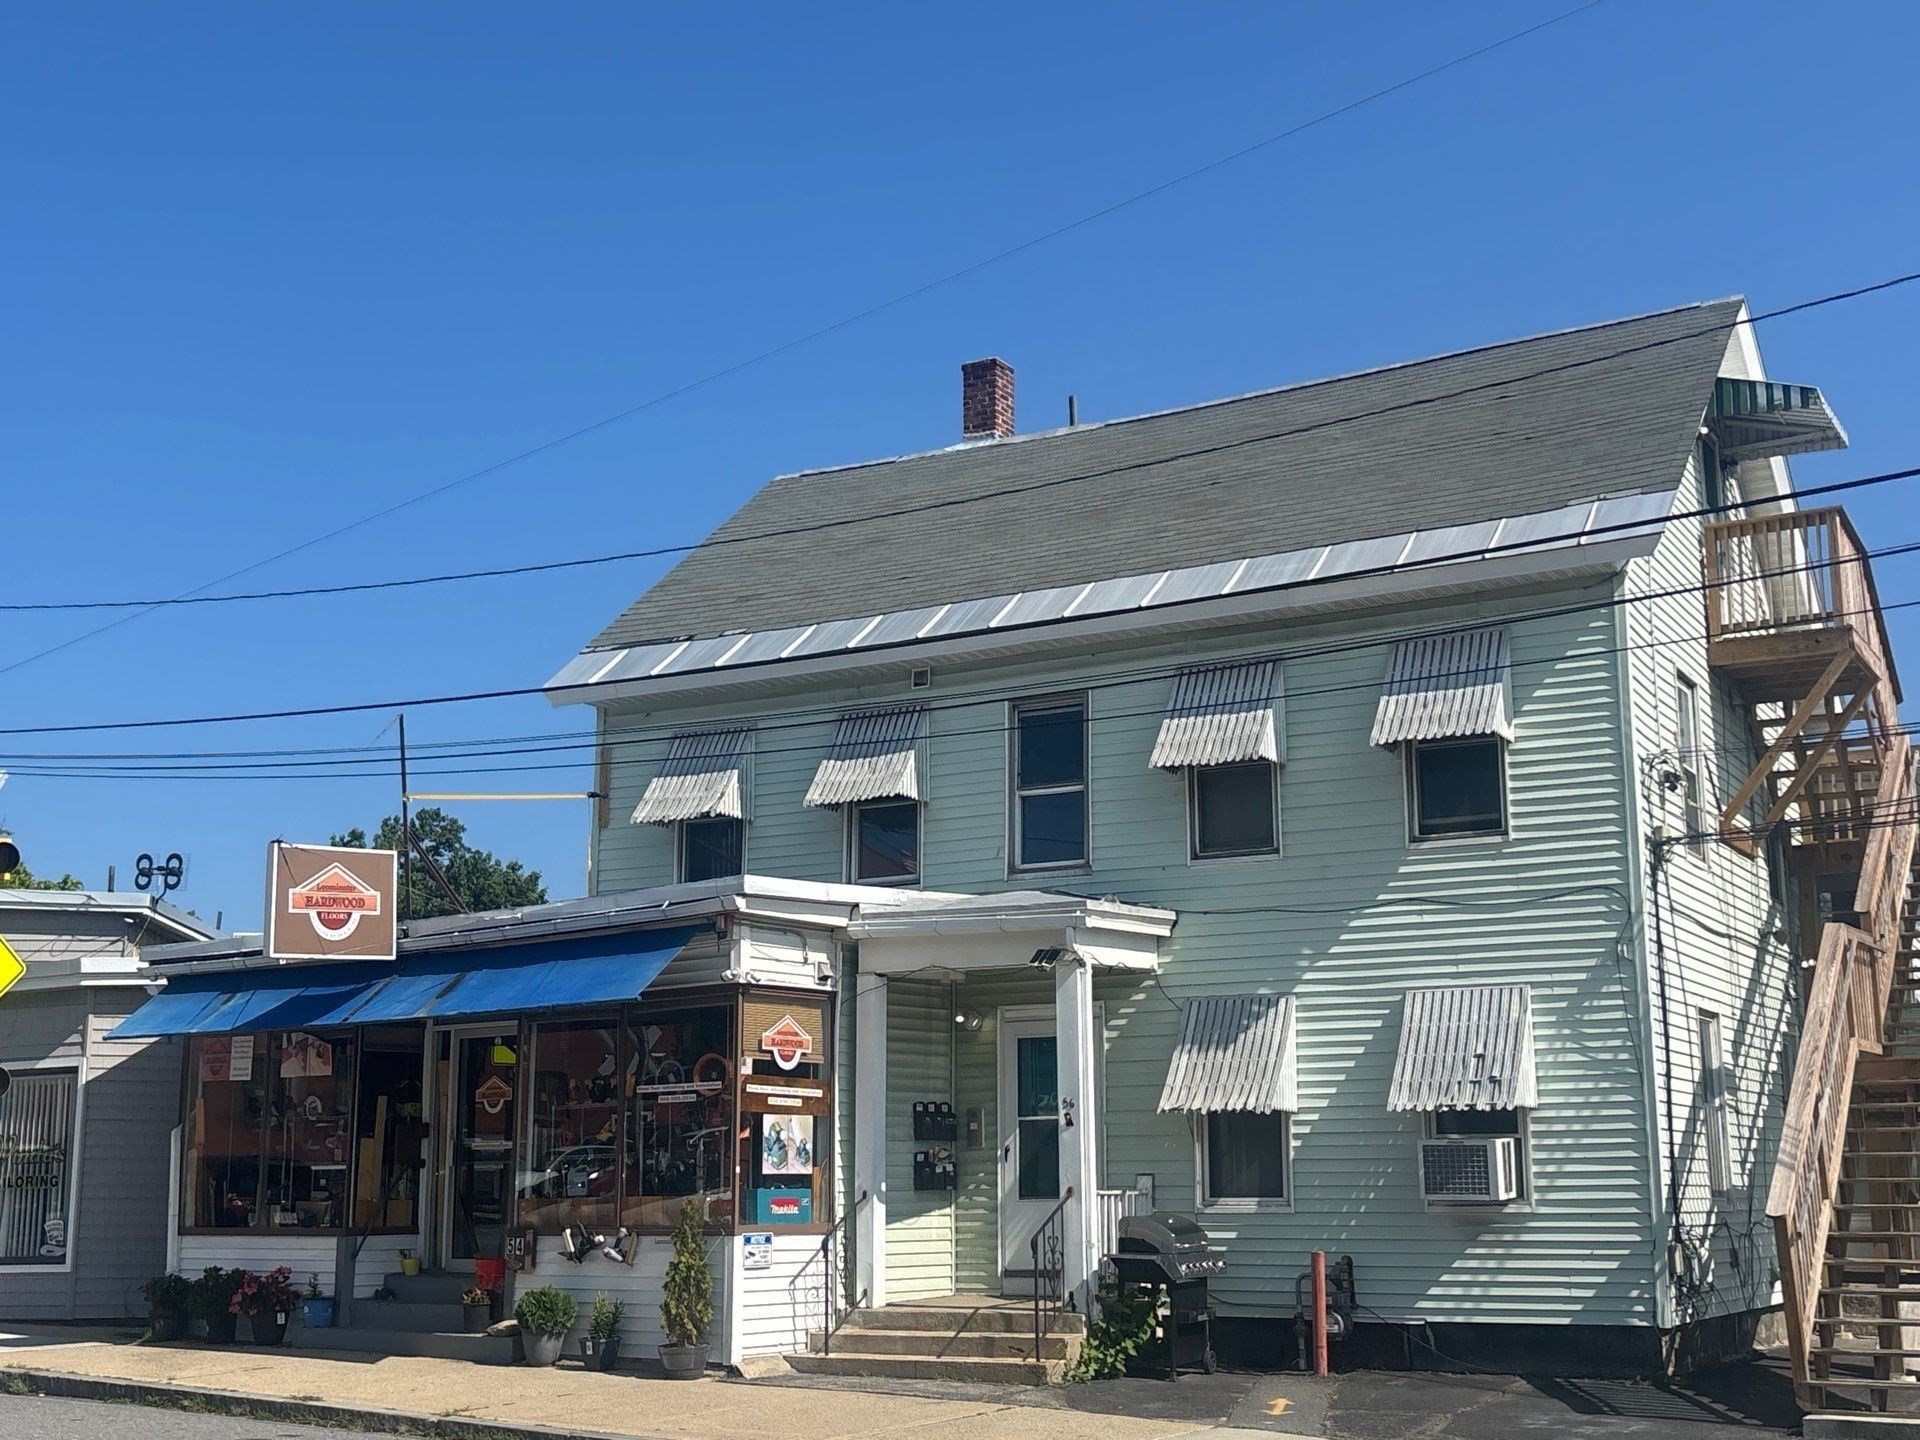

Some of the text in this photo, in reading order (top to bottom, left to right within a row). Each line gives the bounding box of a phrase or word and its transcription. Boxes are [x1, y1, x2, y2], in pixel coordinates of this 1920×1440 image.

[304, 896, 366, 908] HARDWOOD
[1062, 1098, 1075, 1109] 56
[0, 1175, 59, 1188] ILORING
[507, 1238, 523, 1255] 54
